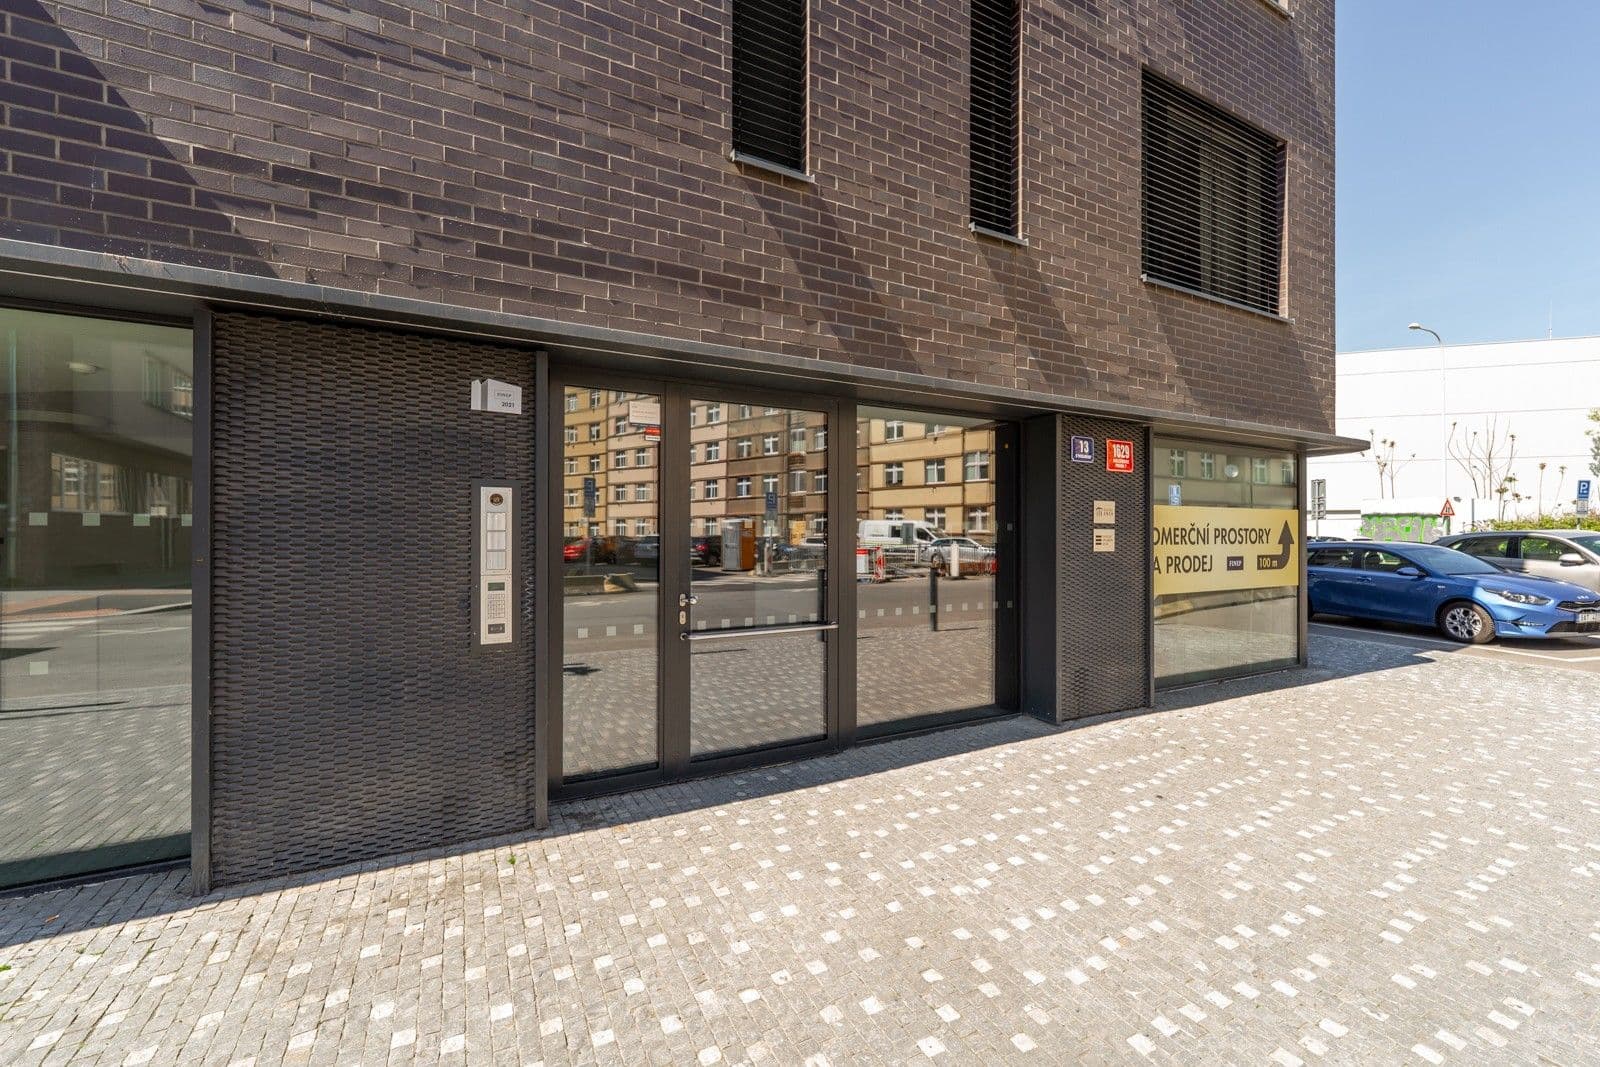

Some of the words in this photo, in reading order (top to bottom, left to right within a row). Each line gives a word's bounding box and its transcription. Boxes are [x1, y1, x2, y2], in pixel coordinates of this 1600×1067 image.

[1079, 440, 1089, 453] 13
[1112, 444, 1130, 459] 1629
[1153, 522, 1210, 545] OMERČNÍ
[1214, 527, 1272, 545] PROSTORY
[1153, 556, 1161, 574] A
[1166, 554, 1213, 574] PRODEJ
[1258, 557, 1271, 568] 100
